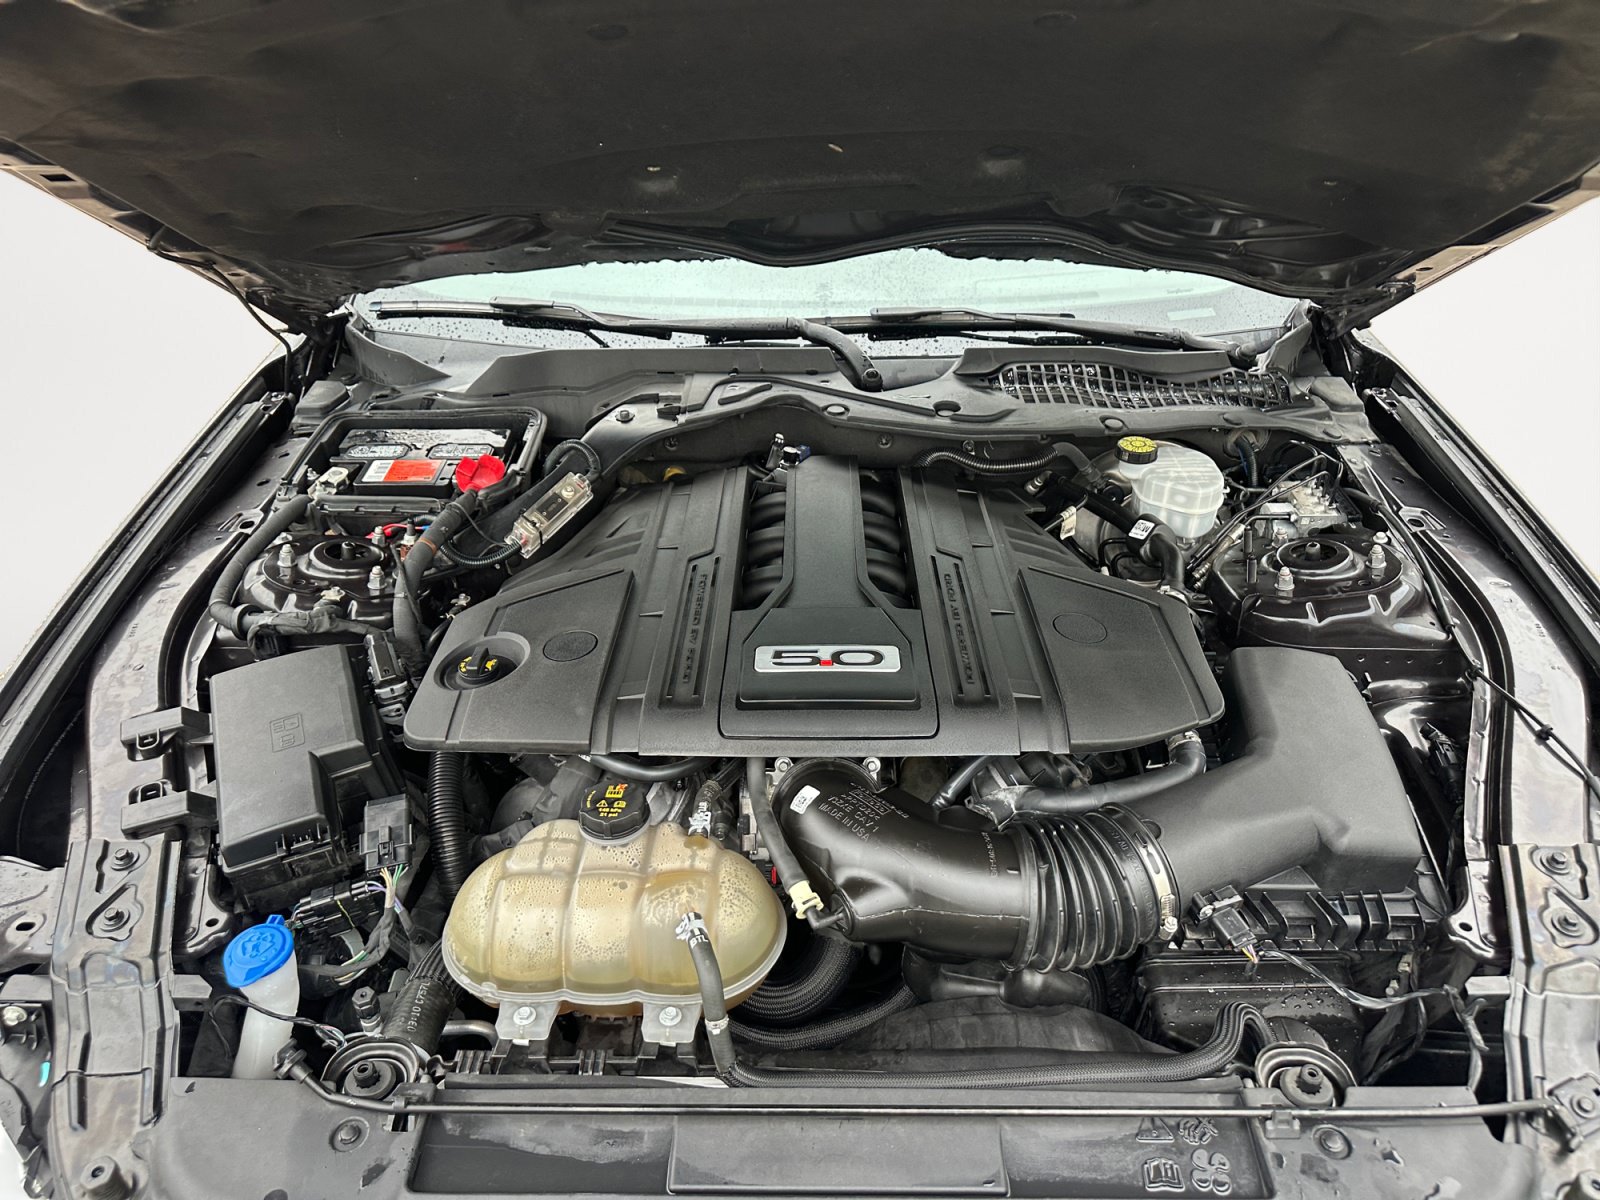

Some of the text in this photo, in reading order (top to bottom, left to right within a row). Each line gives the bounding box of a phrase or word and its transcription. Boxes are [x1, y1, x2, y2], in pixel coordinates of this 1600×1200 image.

[943, 573, 957, 602] FORD
[771, 649, 885, 666] 5.0
[818, 802, 844, 820] MADE
[841, 816, 854, 827] IN
[851, 824, 871, 842] USA
[689, 934, 709, 949] BTL
[407, 1006, 422, 1032] 03:10
